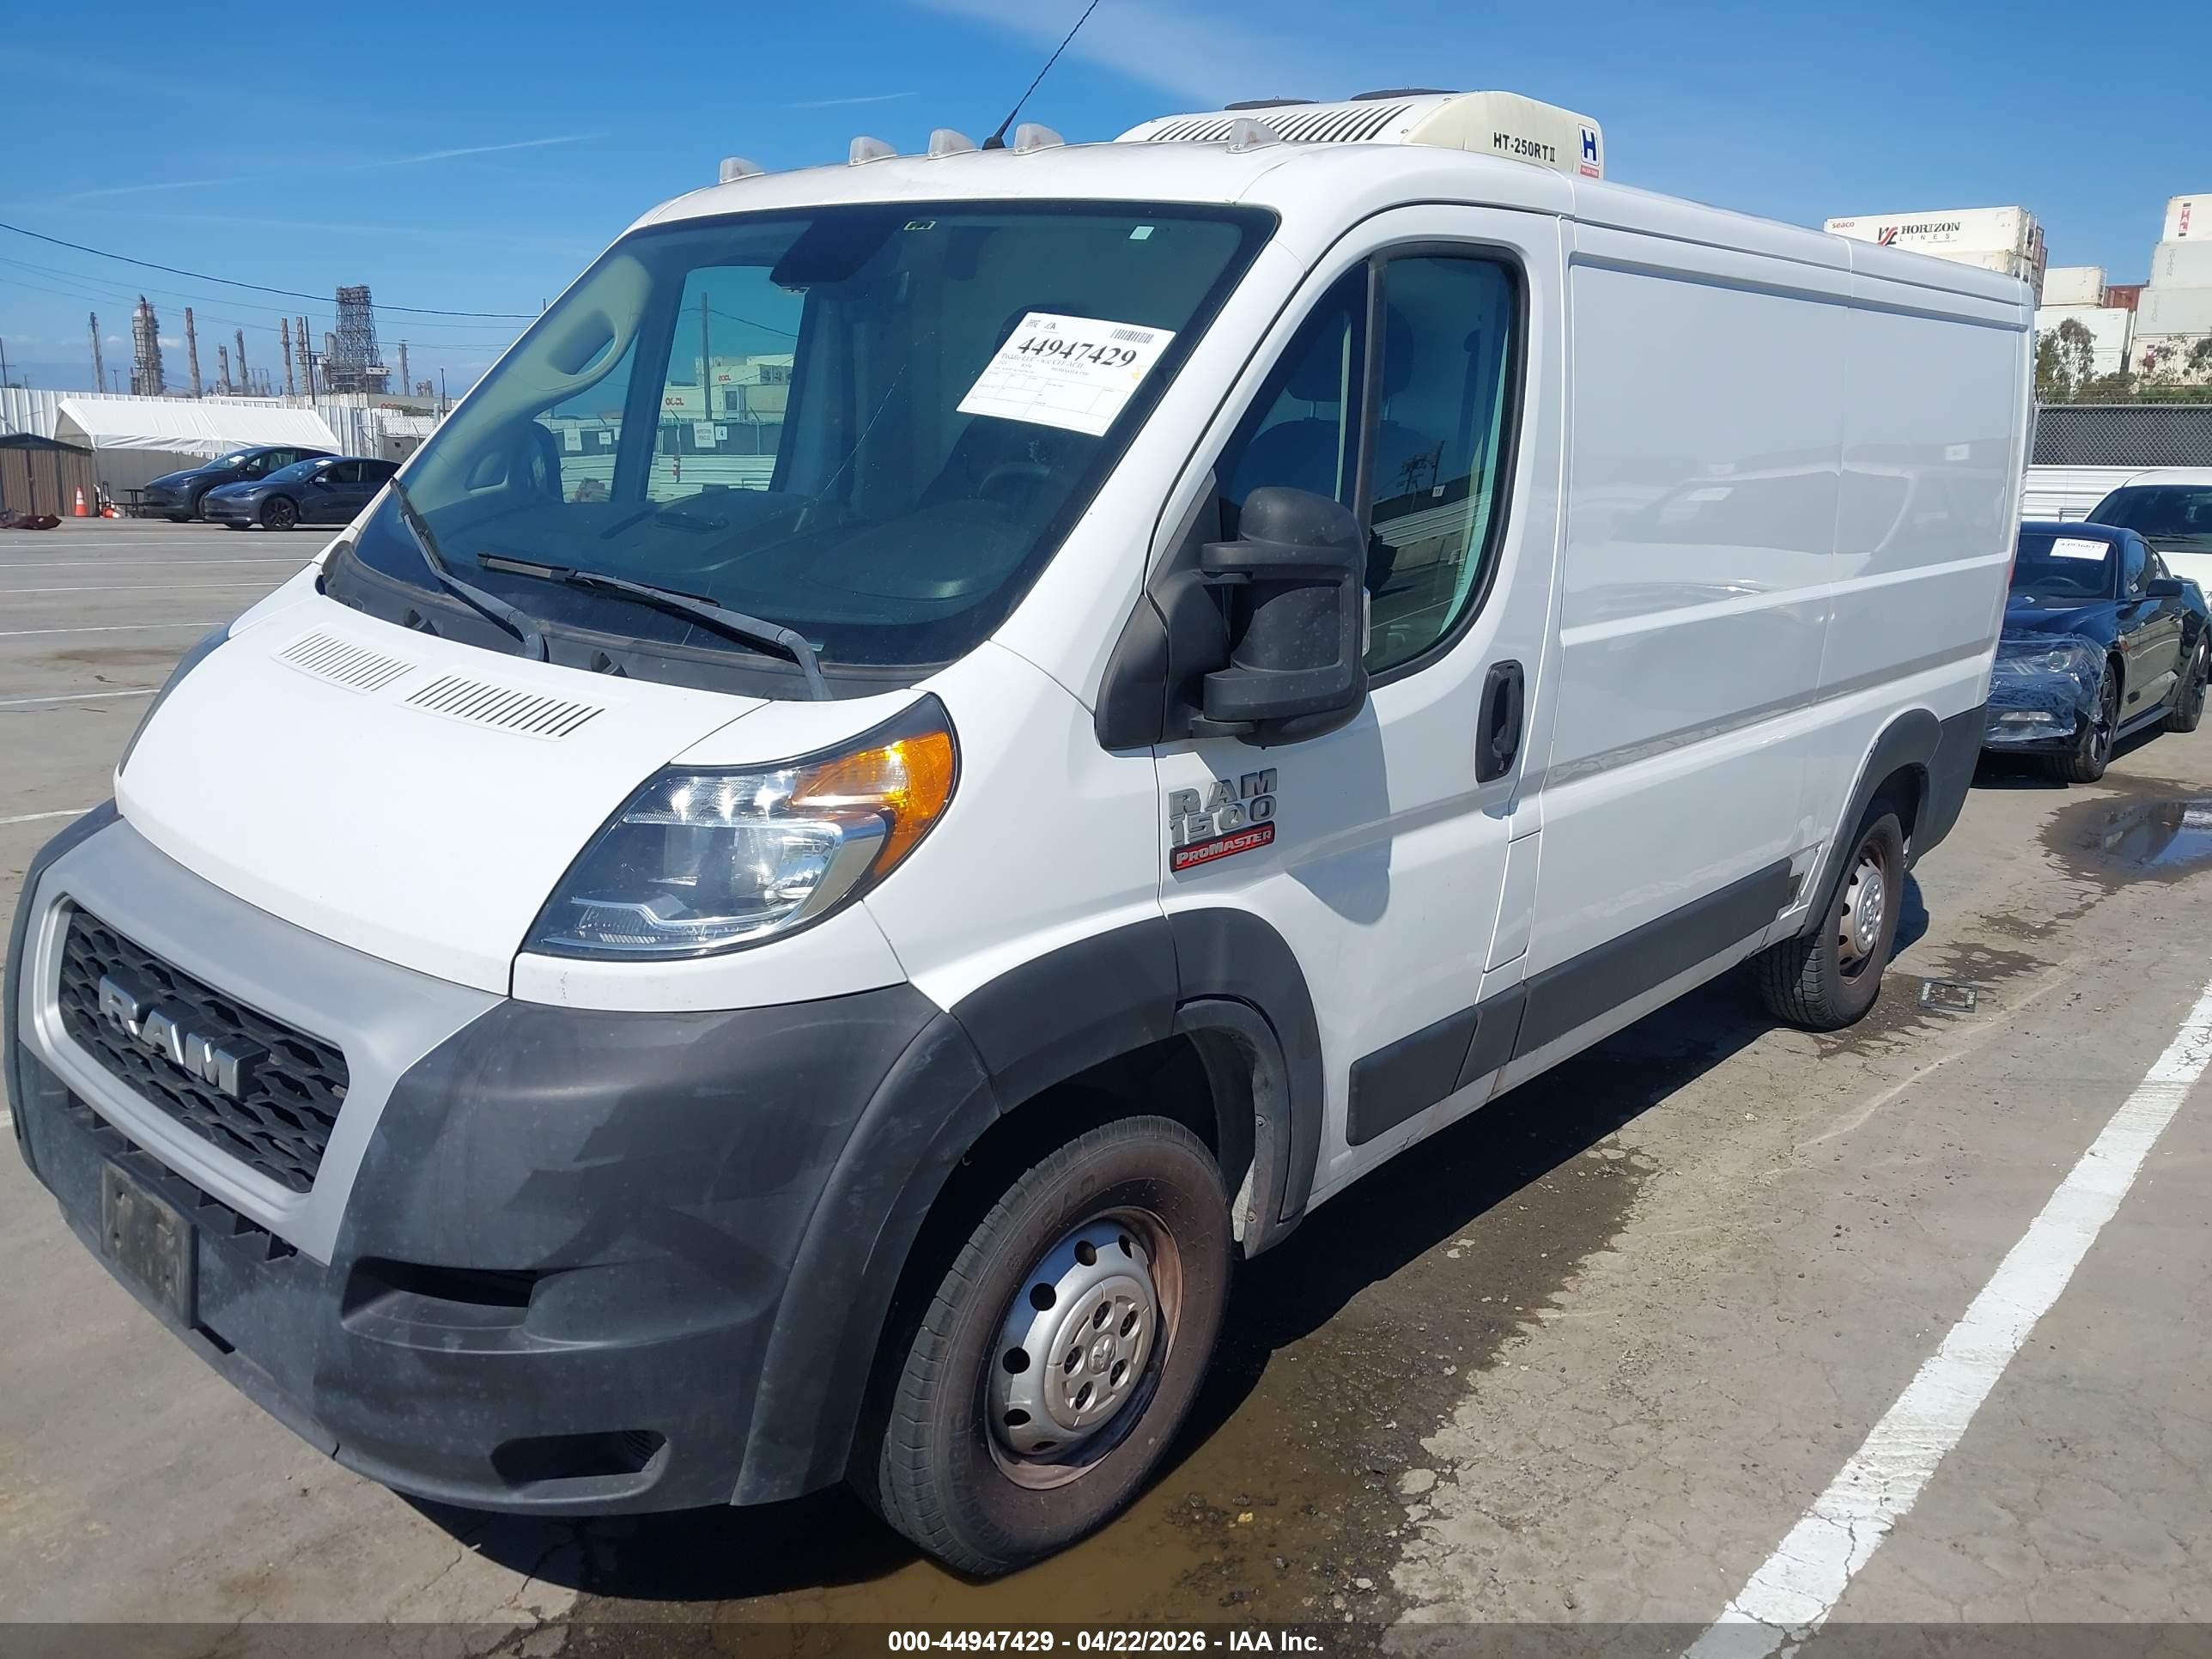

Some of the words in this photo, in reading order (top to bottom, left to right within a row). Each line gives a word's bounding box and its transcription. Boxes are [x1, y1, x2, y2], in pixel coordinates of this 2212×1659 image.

[1832, 221, 1855, 229] seaco
[1899, 222, 1961, 235] HORIZON
[1899, 233, 1951, 242] LINES
[1018, 336, 1137, 368] 44947429
[1169, 768, 1278, 820] RAM
[1170, 795, 1277, 848] 1500
[99, 974, 247, 1098] RAM
